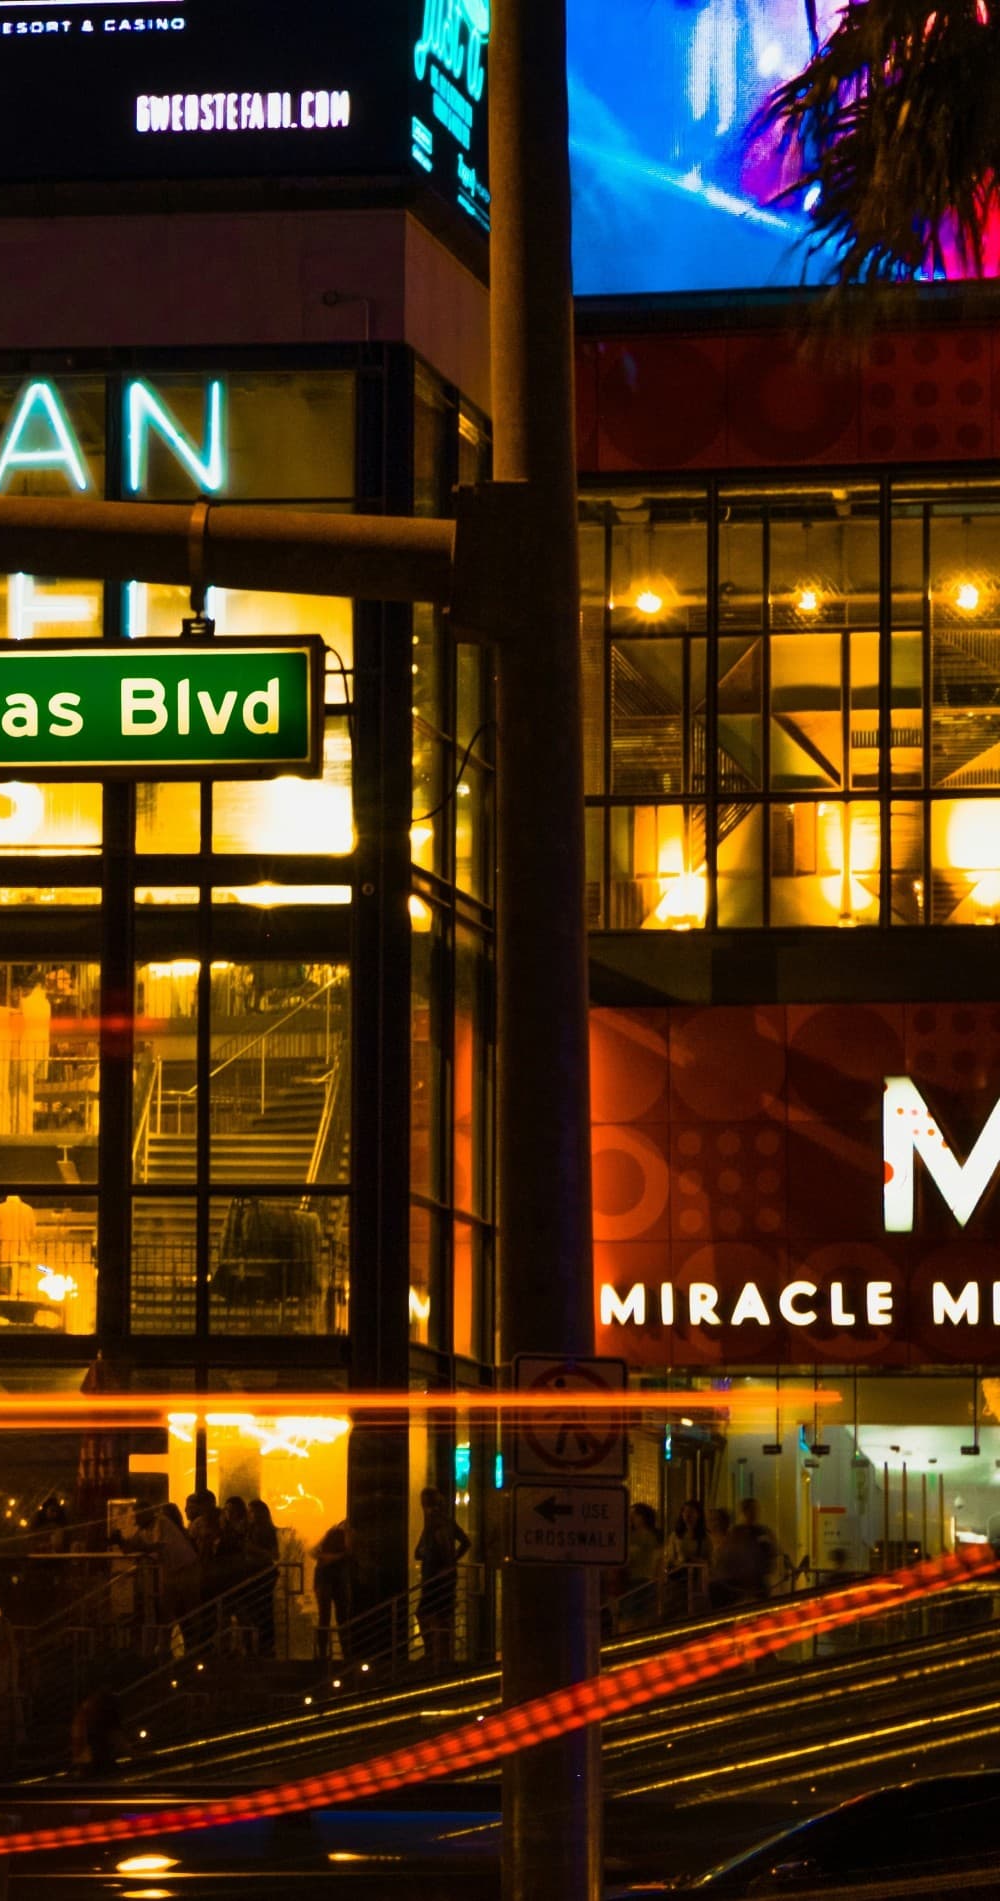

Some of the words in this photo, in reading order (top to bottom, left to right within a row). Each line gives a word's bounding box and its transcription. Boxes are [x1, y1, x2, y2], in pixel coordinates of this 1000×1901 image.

[81, 20, 93, 33] &
[103, 17, 187, 32] CASINO
[120, 677, 280, 737] Blvd
[600, 1280, 893, 1326] MIRACLE
[581, 1503, 609, 1520] USE
[523, 1528, 617, 1547] CROSSWALK
